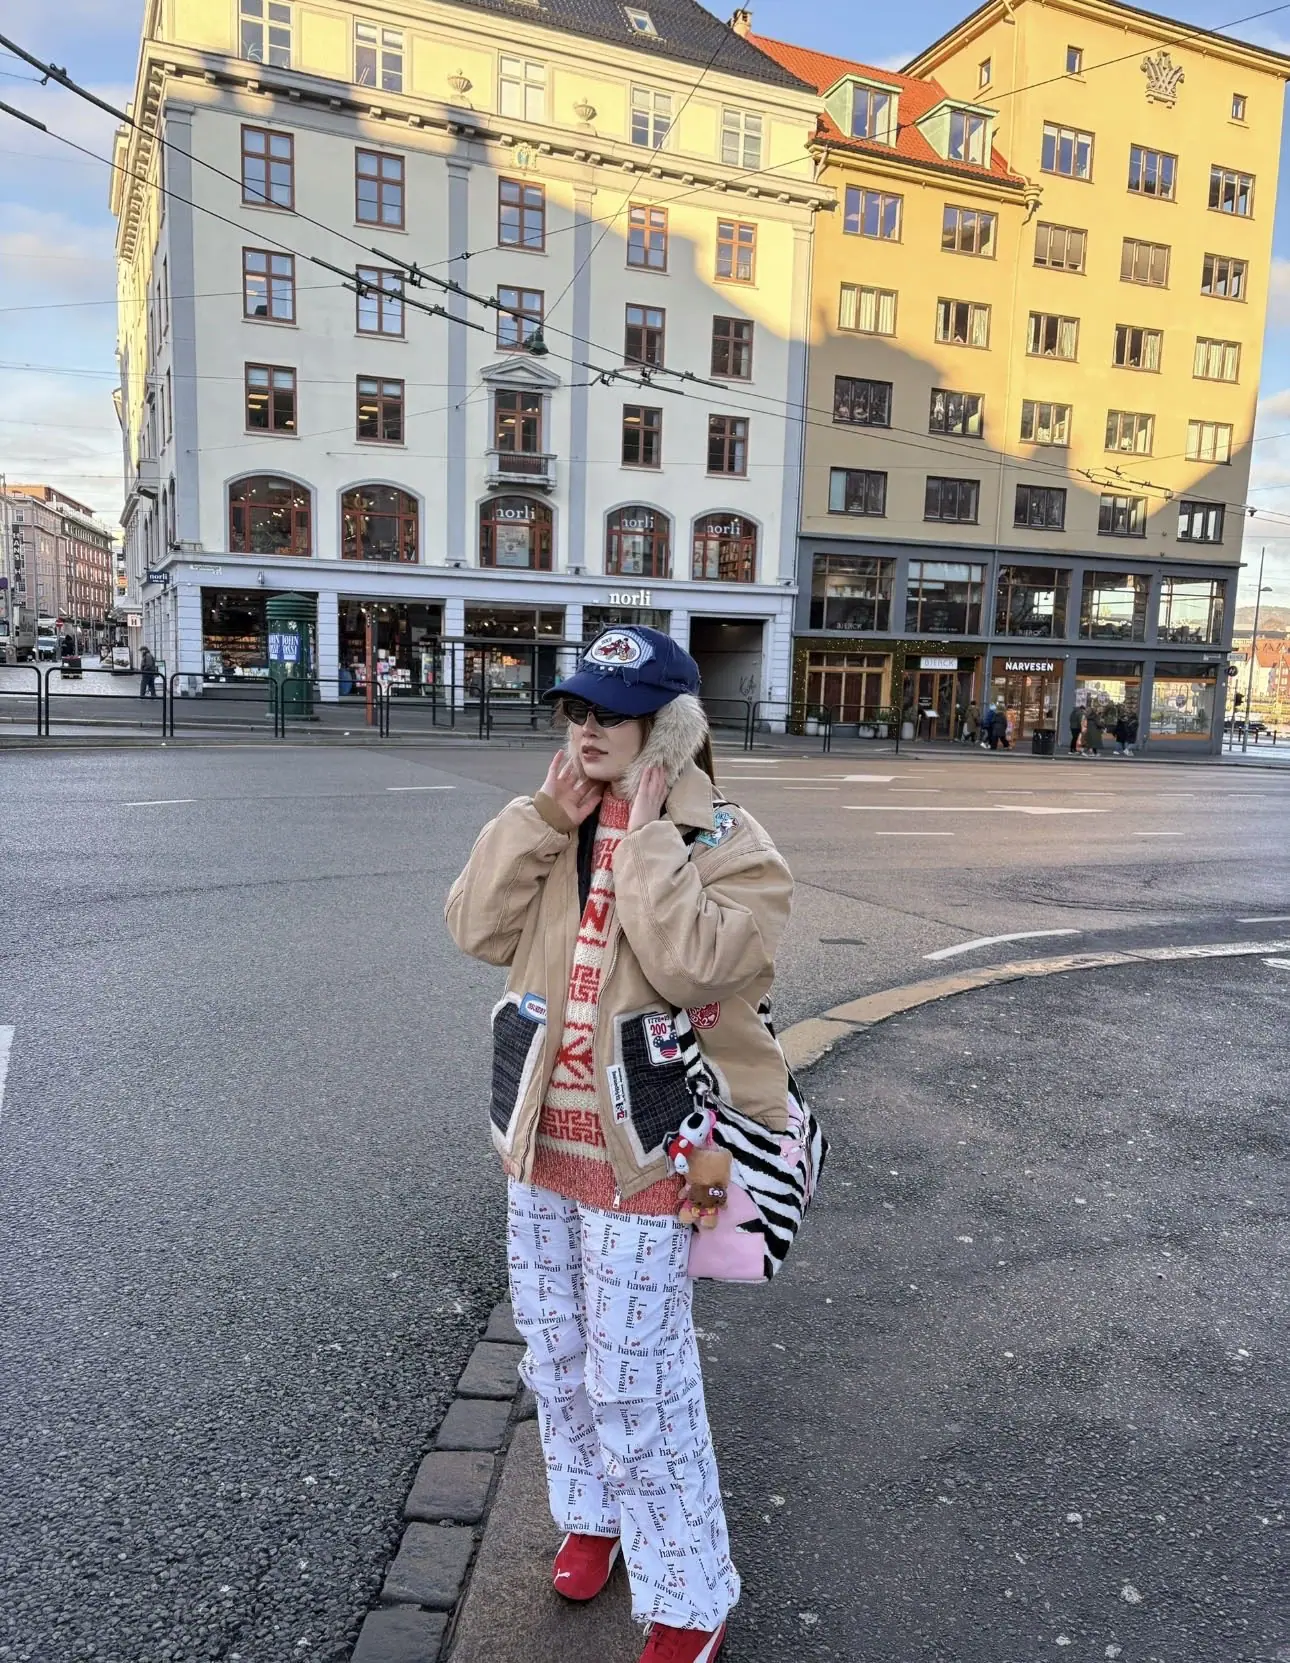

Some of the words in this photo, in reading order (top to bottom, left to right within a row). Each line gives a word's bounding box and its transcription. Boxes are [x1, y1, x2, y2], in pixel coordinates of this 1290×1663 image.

[495, 505, 536, 520] norli
[621, 516, 655, 528] norli
[707, 522, 741, 535] norli
[609, 589, 651, 606] norli
[1005, 662, 1054, 671] NARVESEN
[650, 1023, 667, 1036] 200
